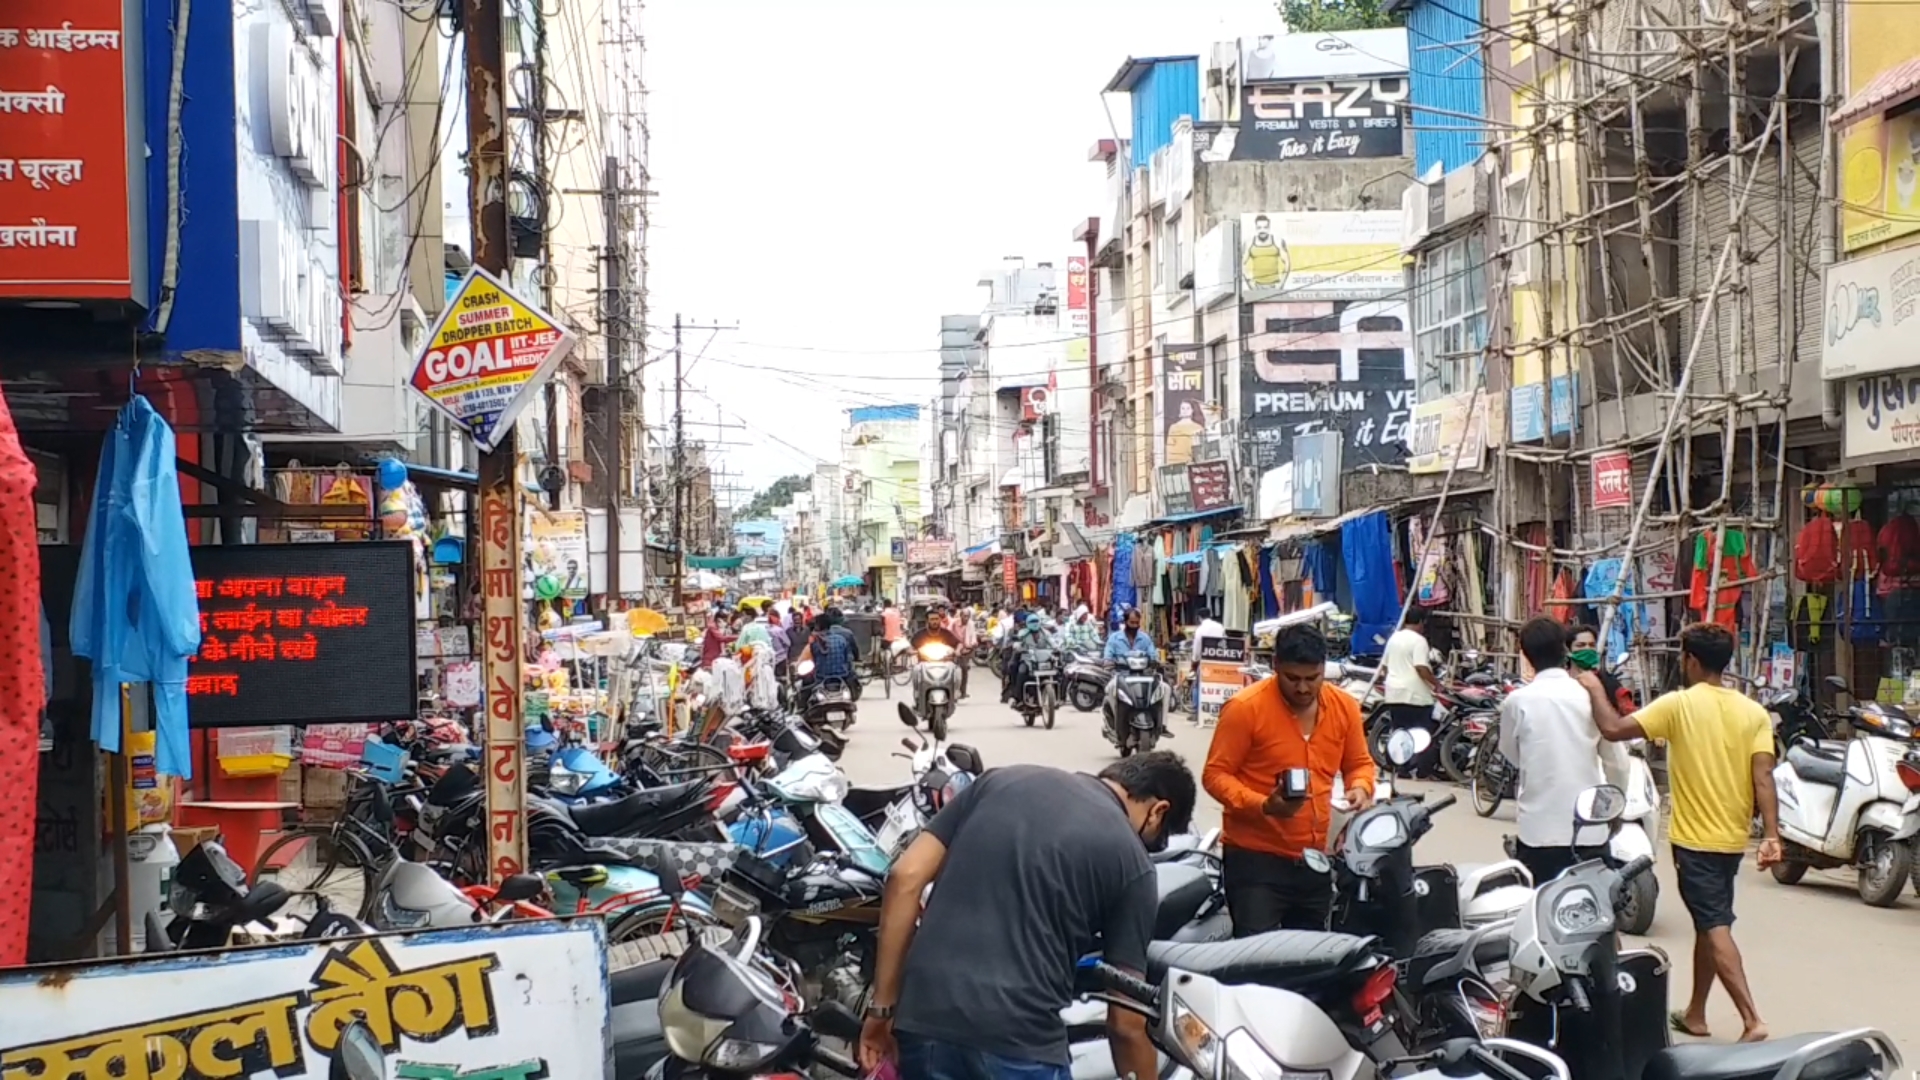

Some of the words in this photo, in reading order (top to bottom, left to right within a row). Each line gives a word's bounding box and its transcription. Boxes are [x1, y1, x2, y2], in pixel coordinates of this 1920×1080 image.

[24, 20, 120, 52] आईटम्स
[1248, 79, 1409, 118] EAZY
[1255, 120, 1299, 131] PREMIUM
[1308, 118, 1340, 130] VESTS
[1363, 117, 1397, 129] BRIEFS
[1278, 137, 1308, 159] Take
[1312, 133, 1325, 153] it
[1326, 130, 1362, 156] Eazy
[18, 158, 83, 190] चूल्हा
[462, 290, 500, 309] CRASH
[458, 306, 510, 326] SUMMER
[442, 325, 493, 343] DROPPER
[495, 317, 533, 332] BATCH
[424, 338, 513, 382] GOAL
[511, 330, 558, 349] IIT-JEE
[1254, 390, 1365, 413] PREMIUM
[1353, 417, 1376, 448] it
[218, 577, 283, 598] अपना
[286, 575, 347, 599] वाहन
[1202, 647, 1243, 659] JOCKEY
[1201, 686, 1221, 696] LUX
